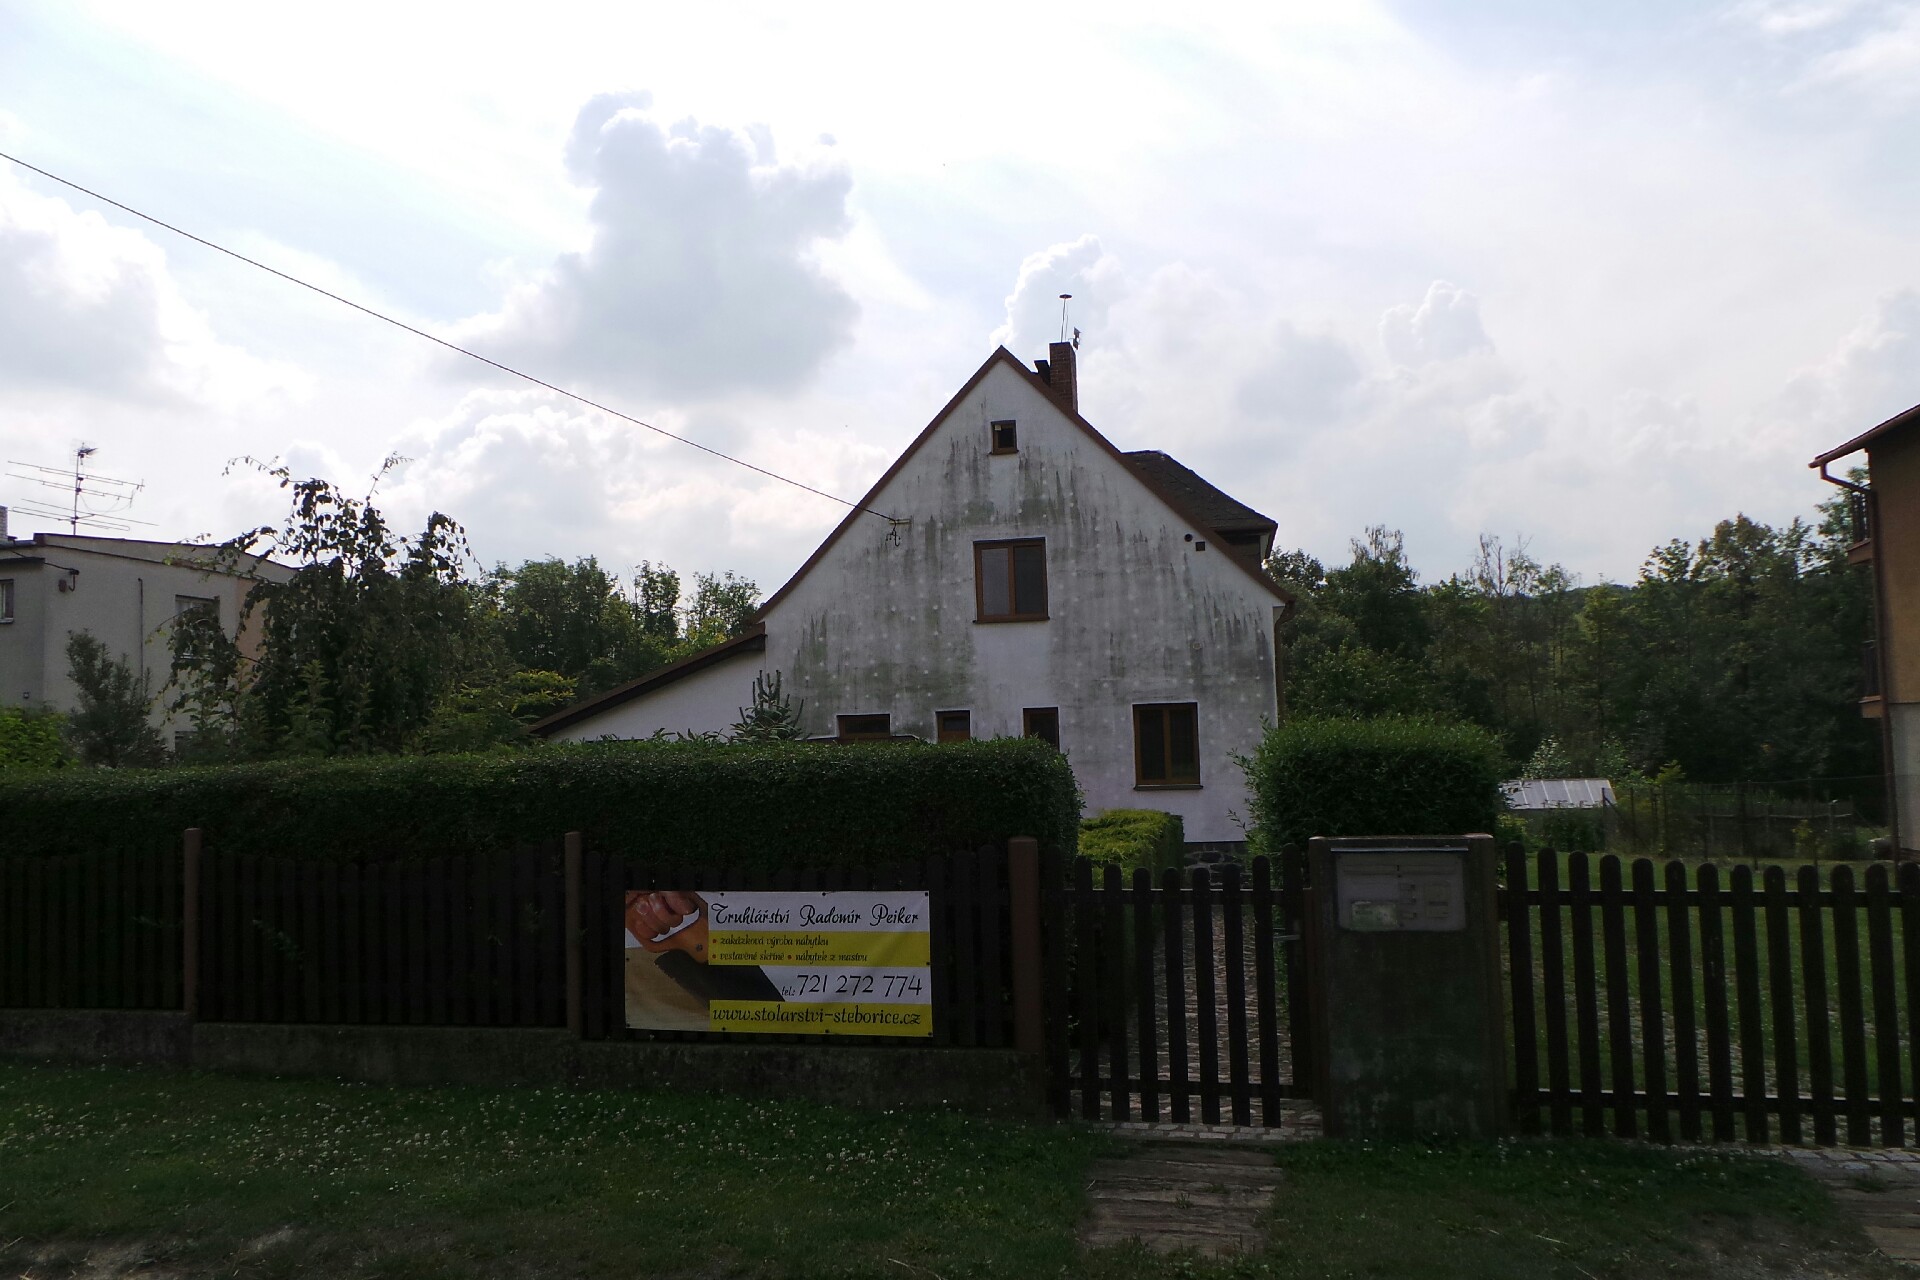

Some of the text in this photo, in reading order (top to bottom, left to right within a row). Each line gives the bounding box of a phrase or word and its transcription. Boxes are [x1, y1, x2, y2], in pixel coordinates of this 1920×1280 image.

[711, 903, 919, 927] Truhlářství Radomír Peiker
[795, 934, 829, 949] nábytku
[795, 950, 828, 964] nábytek
[797, 974, 828, 996] 721
[835, 975, 874, 995] 272
[882, 975, 922, 996] 774
[712, 1005, 921, 1025] www.stolarstvi-steborice.cz
